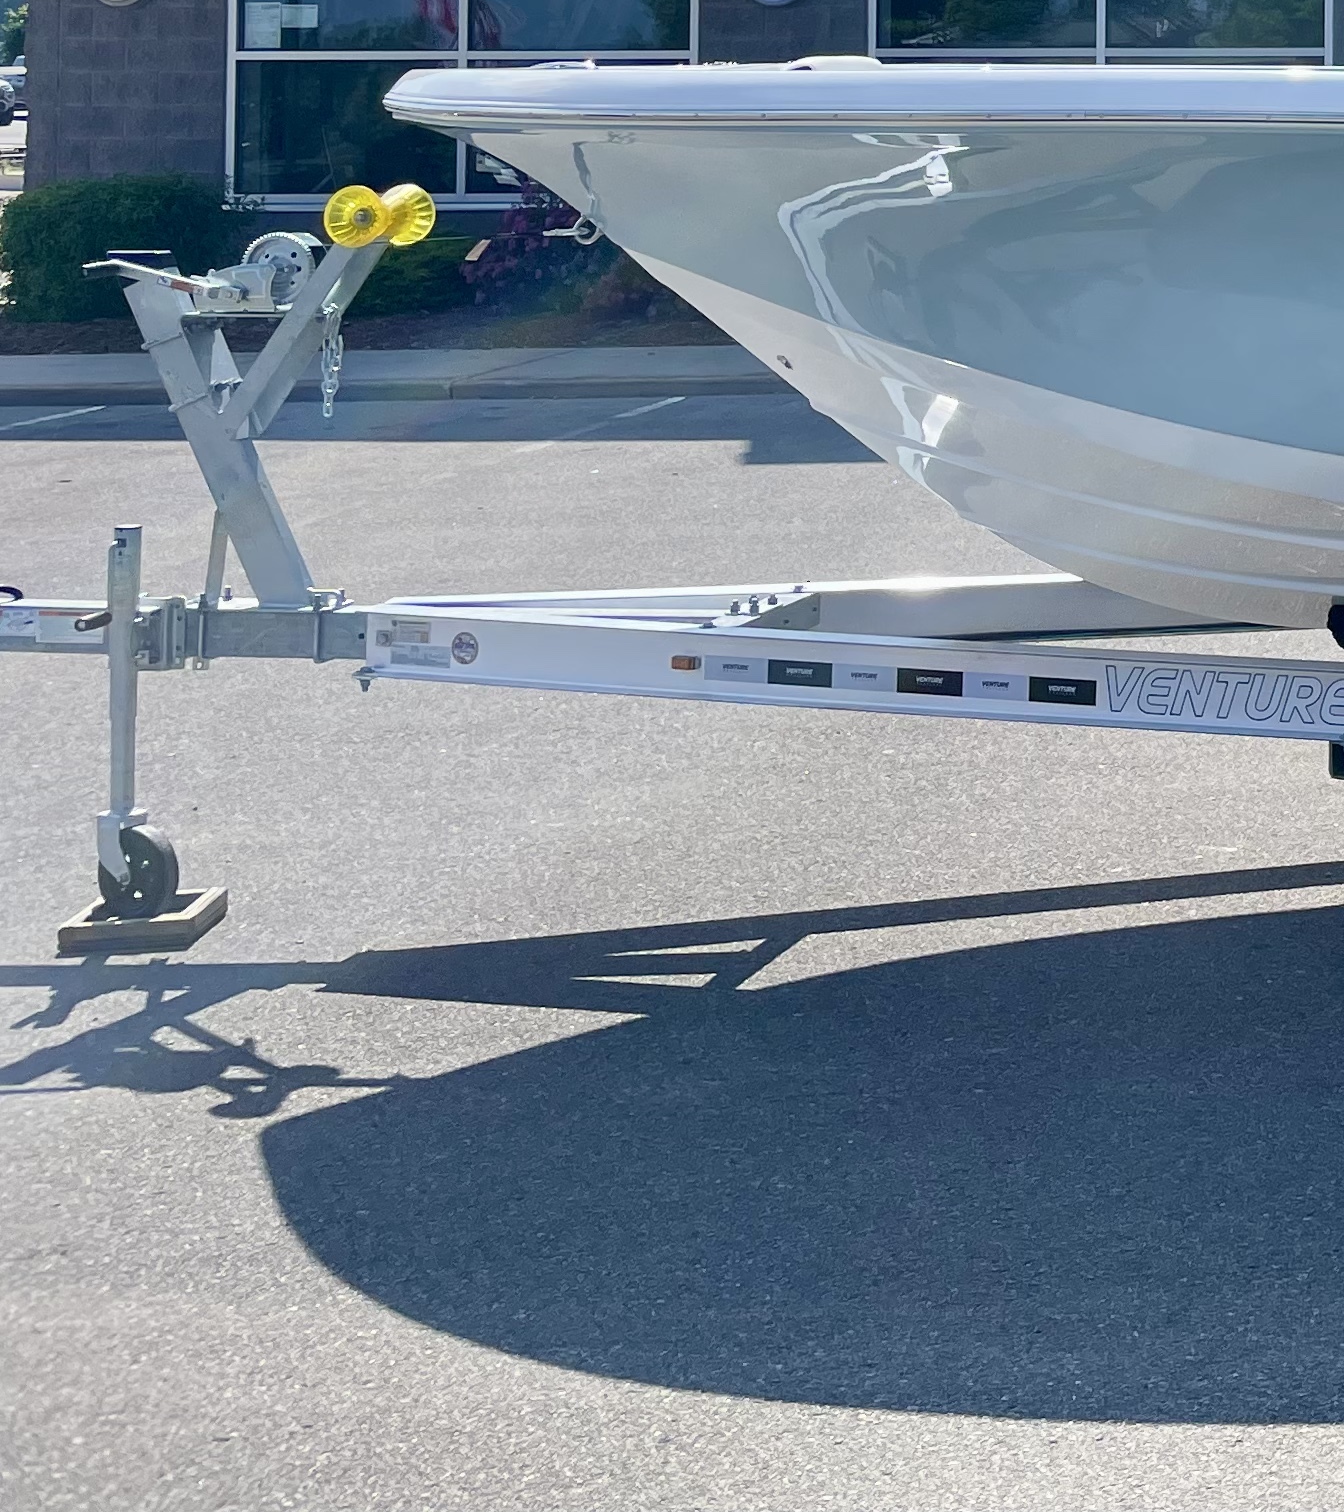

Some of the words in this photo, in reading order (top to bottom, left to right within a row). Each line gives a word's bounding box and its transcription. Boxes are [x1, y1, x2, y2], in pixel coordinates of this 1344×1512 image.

[786, 667, 814, 675] VENTURE
[850, 672, 878, 680] VENTURE
[915, 675, 944, 684] VENTURE
[981, 680, 1010, 689] VENTURE
[1047, 685, 1077, 694] VENTURE
